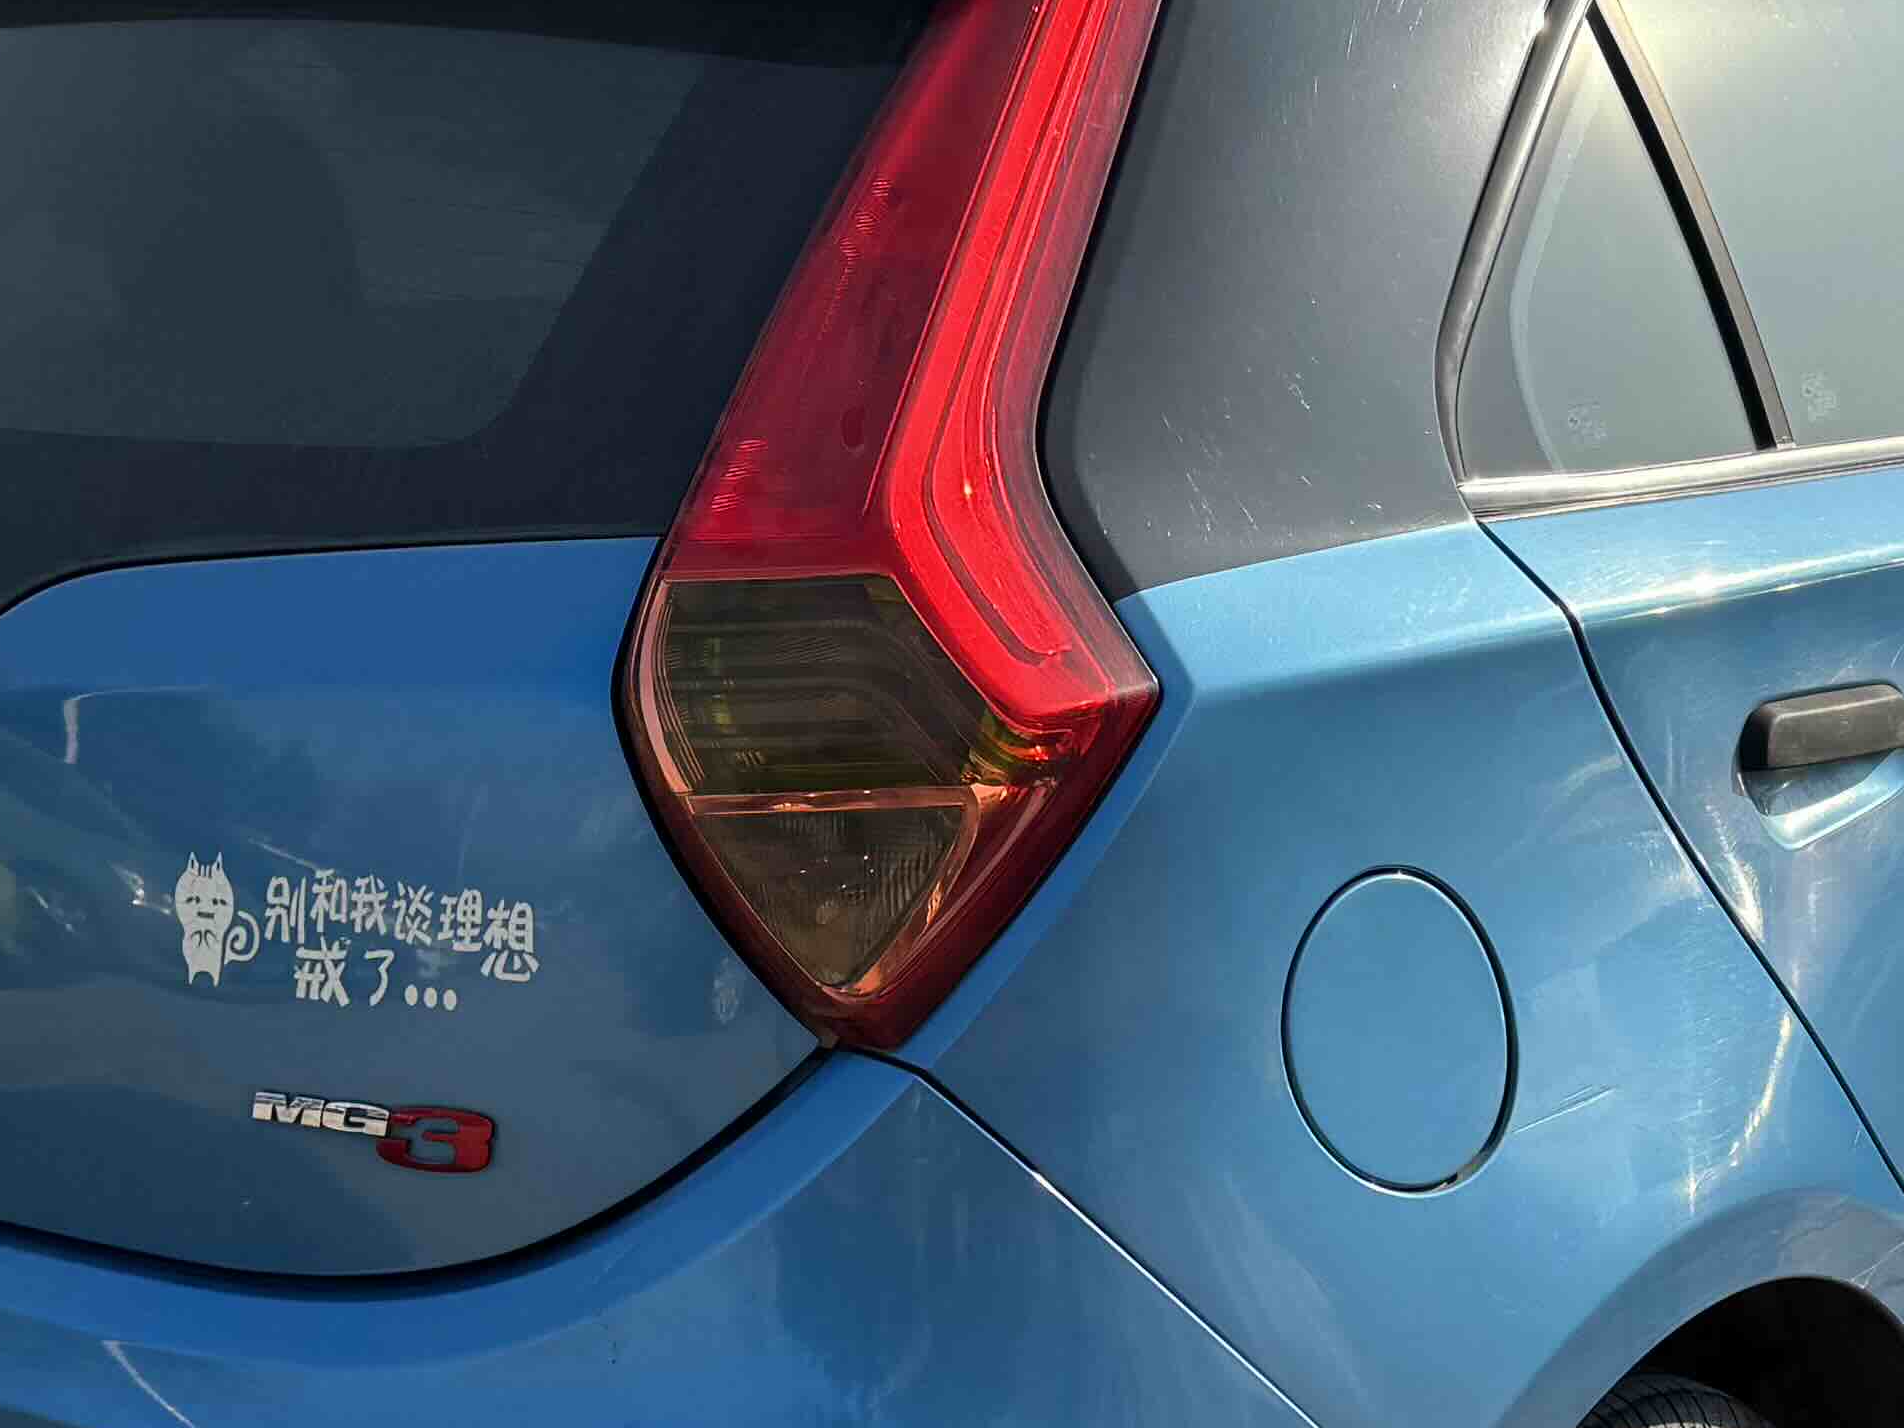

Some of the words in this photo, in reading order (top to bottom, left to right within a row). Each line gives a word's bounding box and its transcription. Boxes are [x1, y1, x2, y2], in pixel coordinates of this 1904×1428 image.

[263, 869, 541, 982] 别和我谈理想
[251, 1090, 496, 1175] MG3
